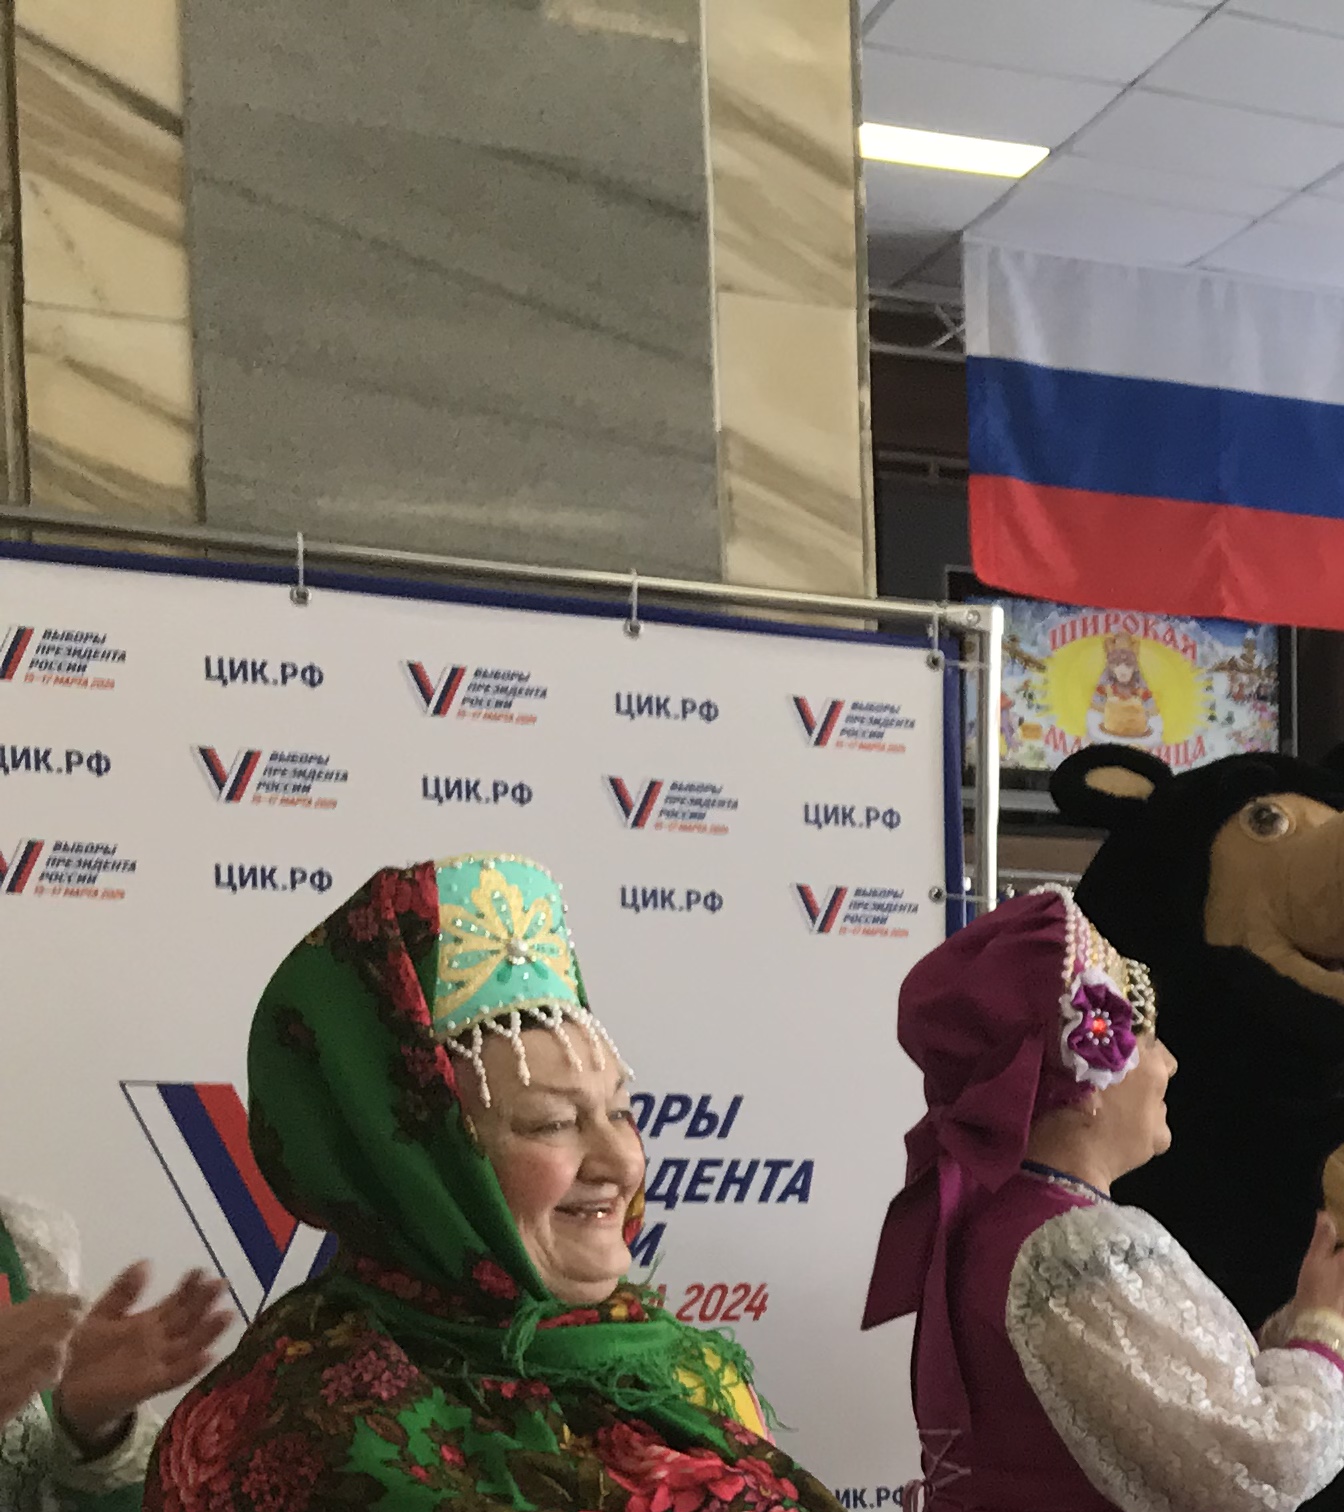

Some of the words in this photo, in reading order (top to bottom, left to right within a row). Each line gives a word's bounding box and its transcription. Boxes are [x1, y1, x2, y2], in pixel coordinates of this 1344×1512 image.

[1050, 613, 1197, 665] ШИРОКАЯ
[205, 655, 324, 689] ЦИК.РФ
[615, 692, 719, 723] ЦИК.РФ
[422, 774, 533, 806] ЦИК.РФ
[803, 802, 901, 831] ЦИК.РФ
[215, 863, 333, 894] ЦИК.РФ
[620, 885, 724, 914] ЦИК.РФ
[630, 1092, 744, 1139] ОРЫ
[645, 1158, 815, 1211] ДЕНТА
[675, 1282, 770, 1323] 2024
